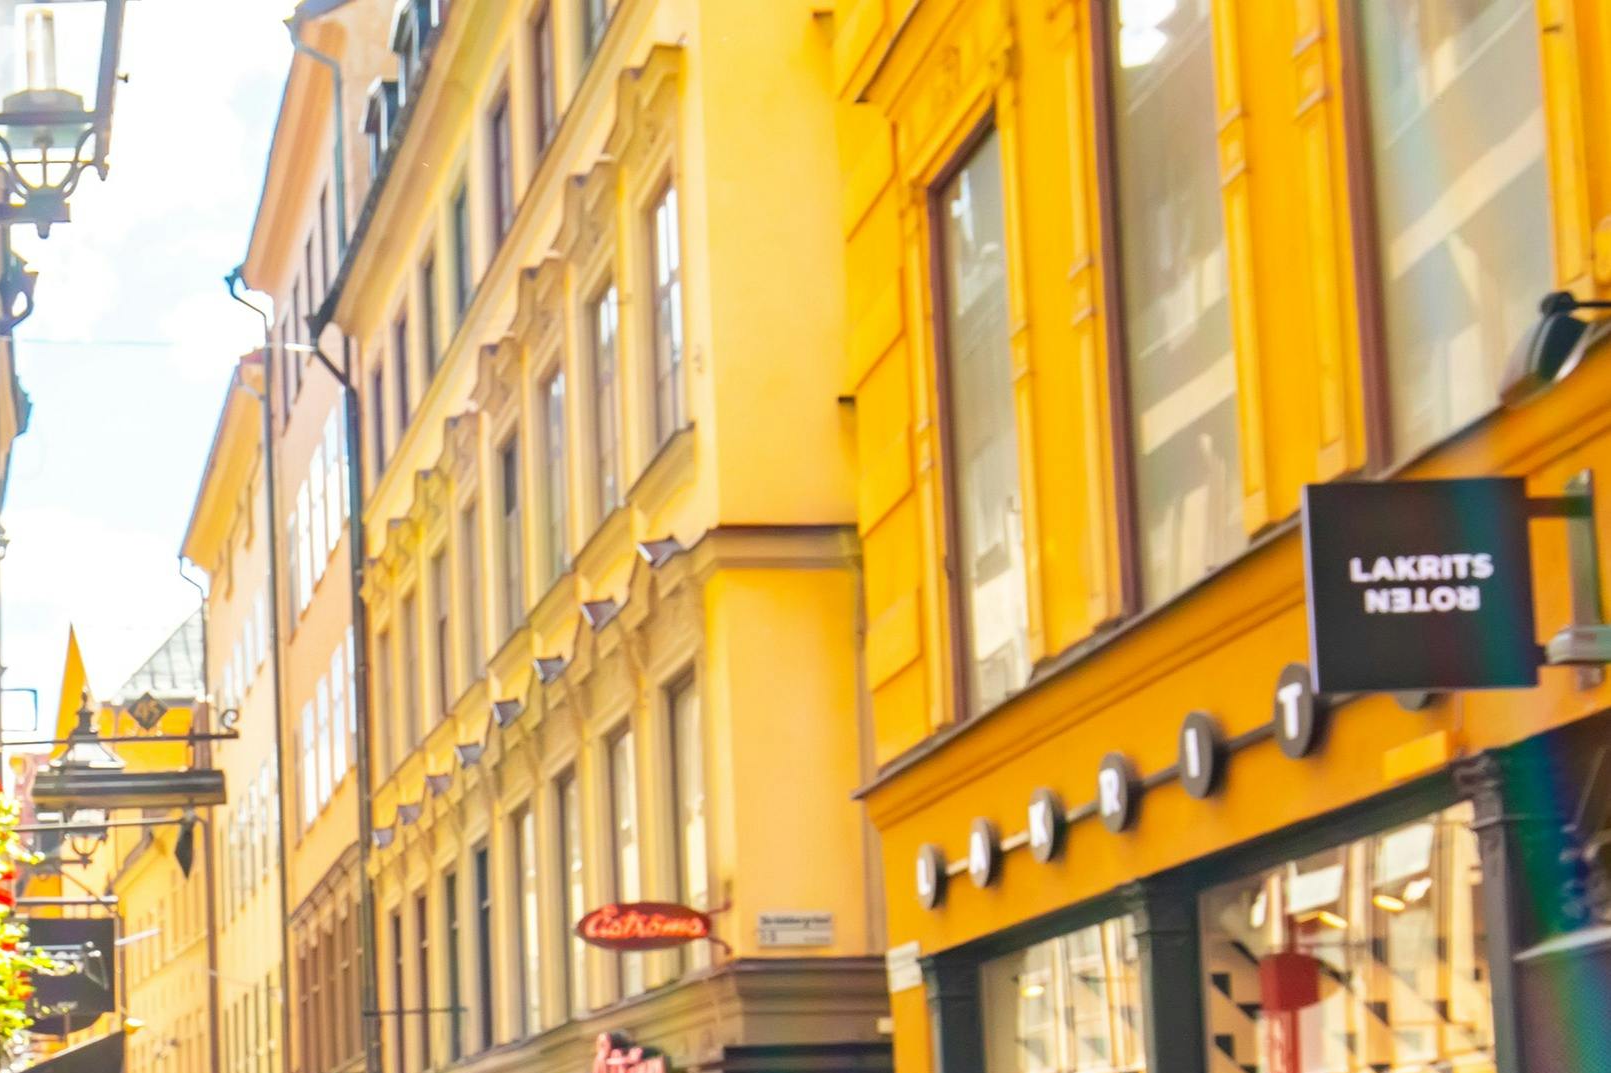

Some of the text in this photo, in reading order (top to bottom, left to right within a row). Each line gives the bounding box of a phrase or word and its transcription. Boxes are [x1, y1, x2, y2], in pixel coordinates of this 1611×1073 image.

[1349, 553, 1494, 582] LAKRITS
[1364, 586, 1481, 613] ROTEN
[916, 681, 1304, 897] LAKRIT
